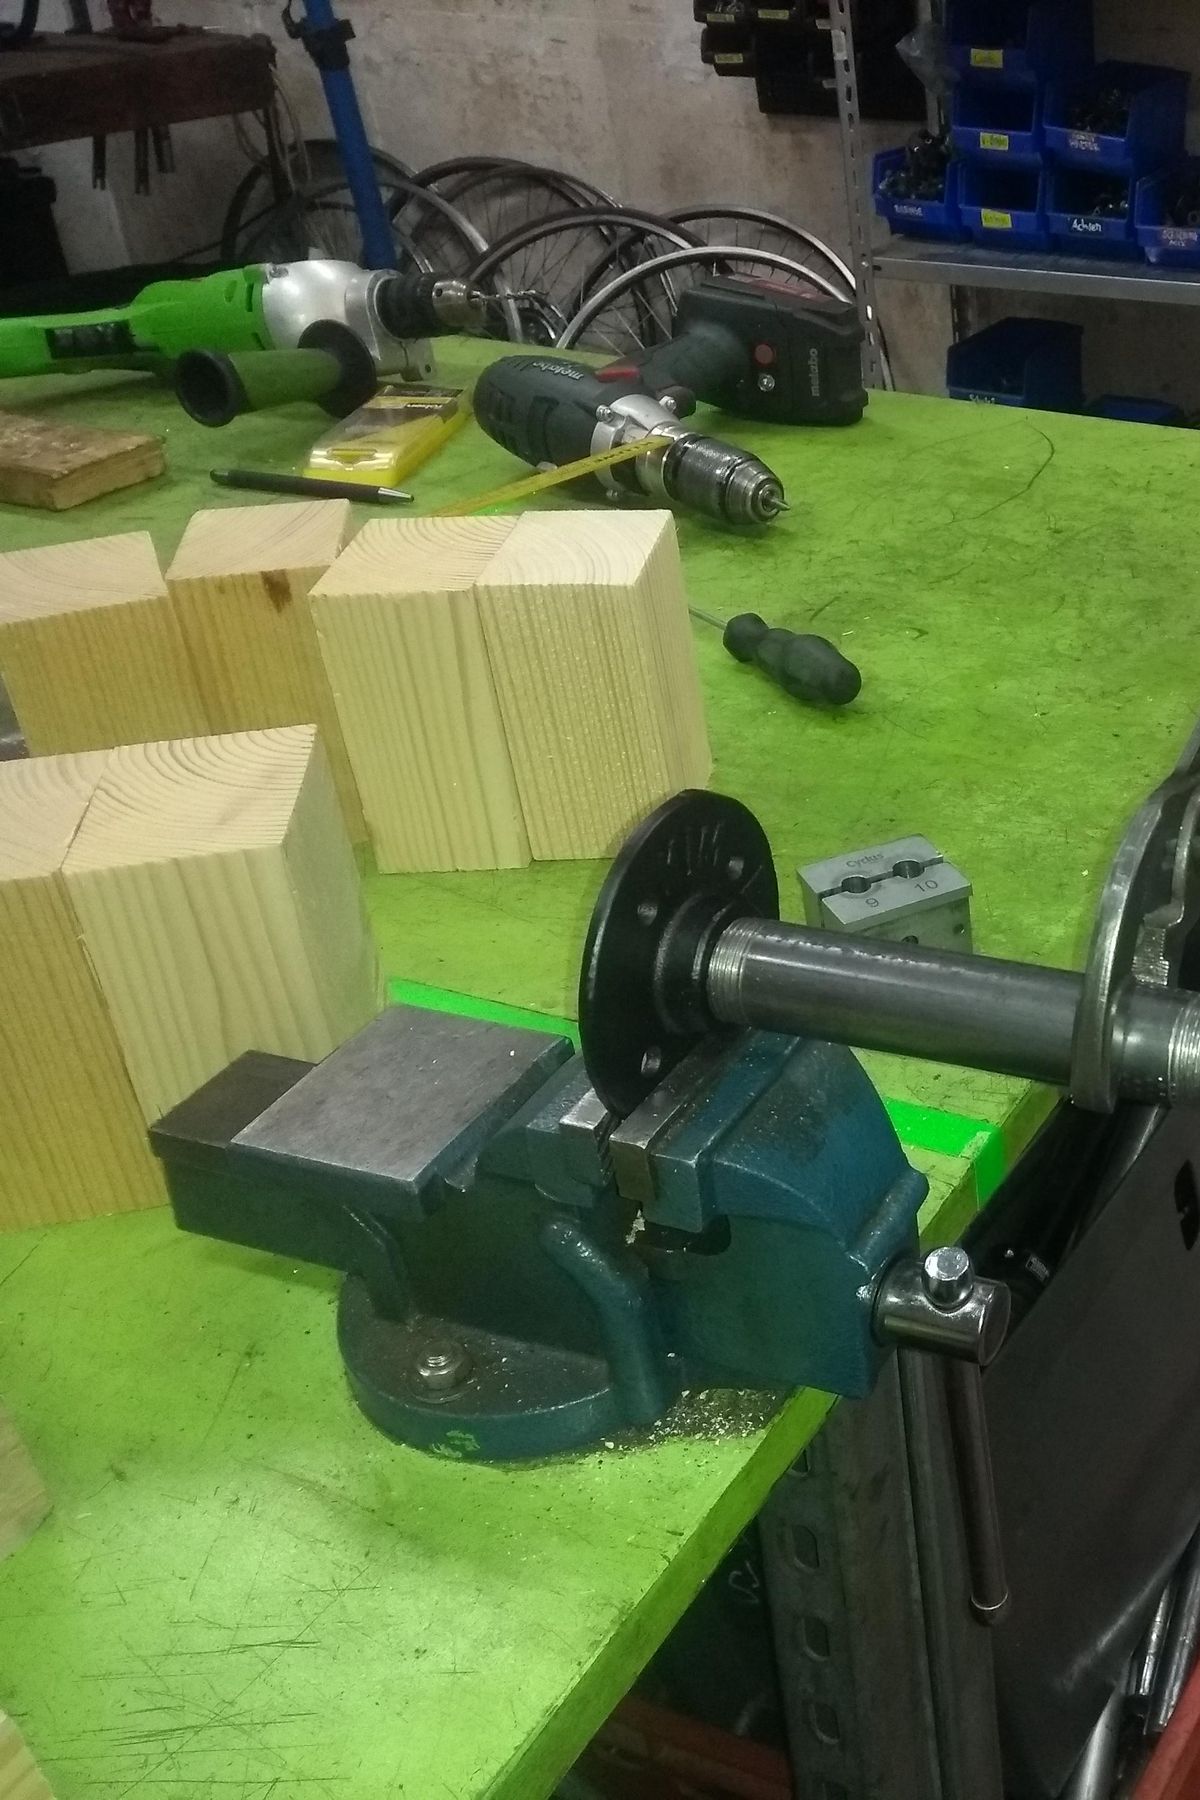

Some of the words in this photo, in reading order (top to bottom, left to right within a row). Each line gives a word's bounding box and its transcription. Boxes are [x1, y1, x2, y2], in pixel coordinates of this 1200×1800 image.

[1072, 218, 1102, 232] Achsen
[532, 361, 584, 380] metabo
[808, 348, 820, 397] metabo
[846, 852, 885, 868] Cyclus
[865, 897, 879, 908] 9
[914, 879, 939, 892] 10
